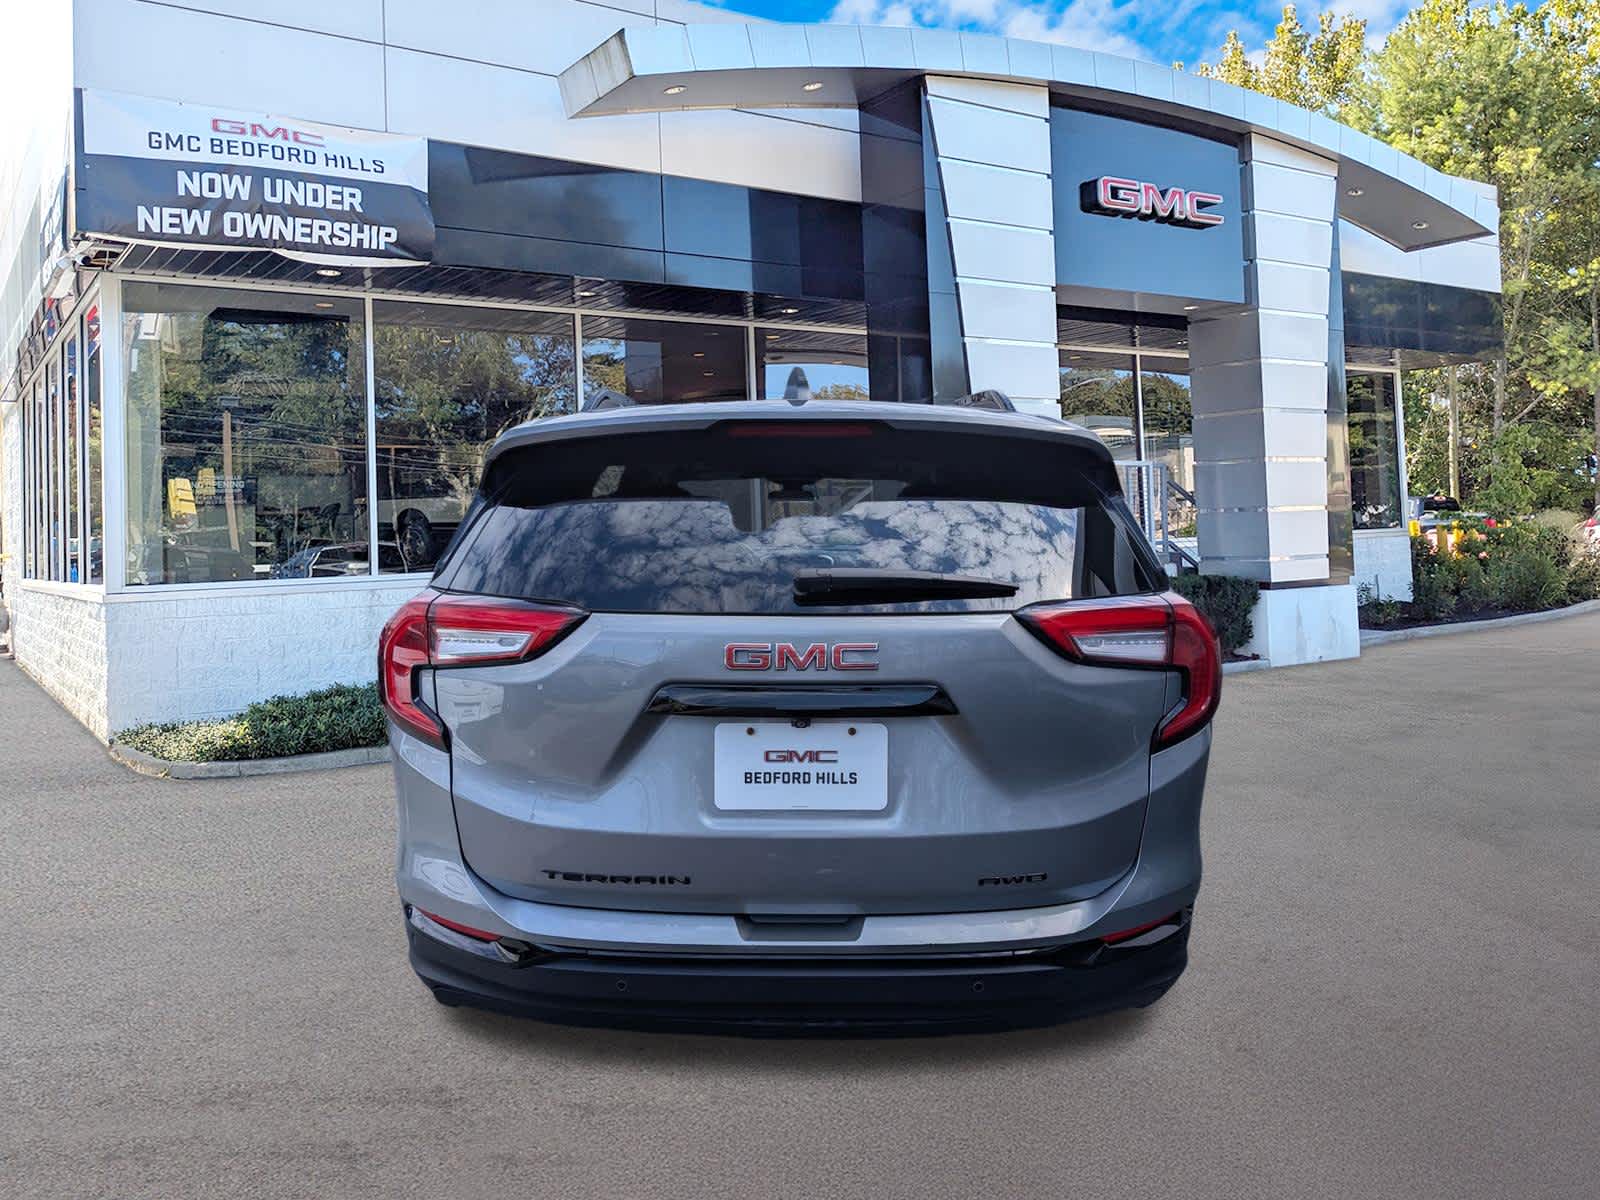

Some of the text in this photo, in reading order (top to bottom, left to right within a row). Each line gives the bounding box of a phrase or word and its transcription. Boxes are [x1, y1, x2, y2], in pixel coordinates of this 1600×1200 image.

[211, 118, 325, 148] GMC
[148, 131, 385, 173] GMC BEDFORD HILLS
[177, 170, 364, 213] NOW UNDER
[1098, 176, 1224, 224] GMC
[136, 206, 398, 250] NEW OWNERSHIP
[723, 642, 879, 670] GMC
[764, 750, 838, 763] GMC
[744, 772, 857, 784] BEDFORD HILLS
[541, 869, 691, 885] TERRAIN
